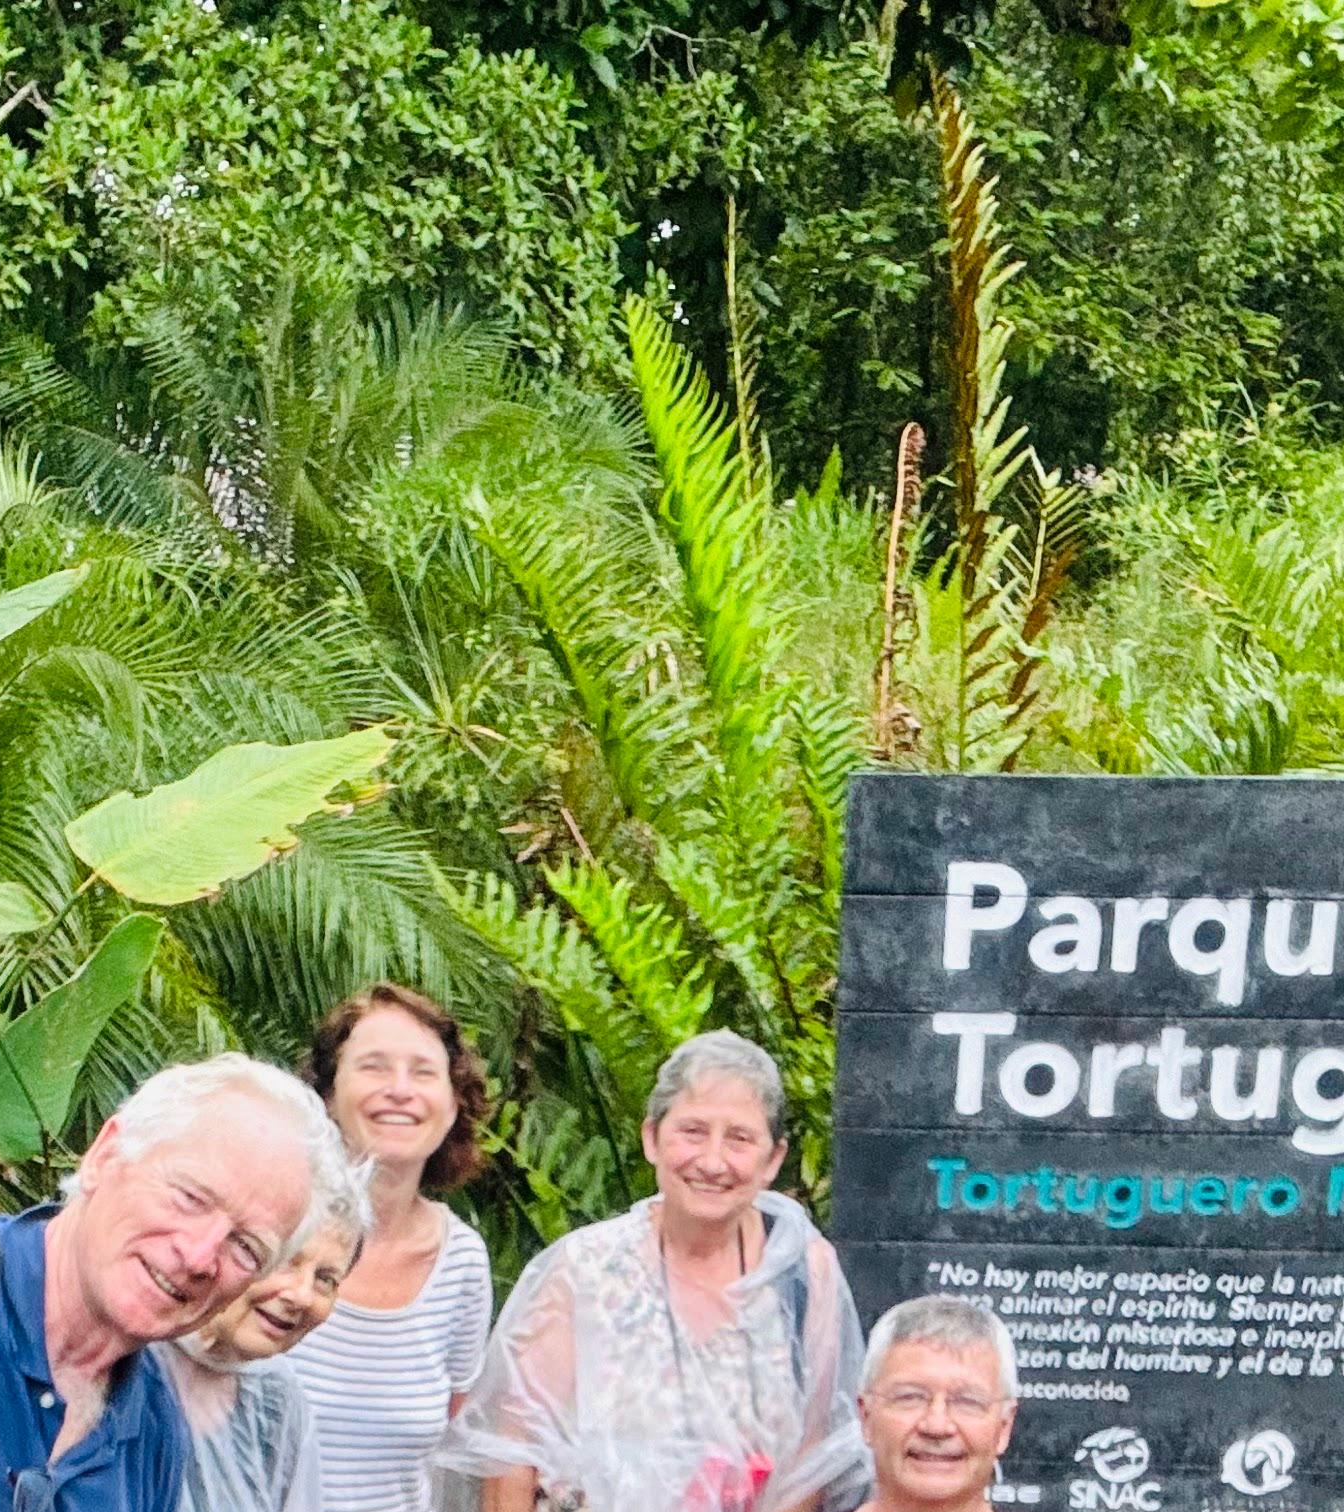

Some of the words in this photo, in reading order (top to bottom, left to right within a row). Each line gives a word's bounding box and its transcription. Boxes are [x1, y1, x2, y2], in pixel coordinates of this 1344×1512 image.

[927, 1156, 1301, 1230] Tortuguero
[983, 1262, 1029, 1294] hay
[1034, 1263, 1109, 1295] mejor
[1112, 1268, 1211, 1296] espacio
[1215, 1273, 1265, 1298] que
[1271, 1265, 1295, 1295] la
[999, 1292, 1089, 1316] animar
[1091, 1291, 1117, 1316] el
[1229, 1295, 1335, 1327] Siempre
[1005, 1317, 1100, 1343] onexión
[1107, 1320, 1237, 1347] misteriosa
[1240, 1328, 1259, 1347] e
[1067, 1344, 1110, 1370] del
[1114, 1346, 1212, 1373] hombre
[1216, 1356, 1233, 1379] y
[1238, 1349, 1265, 1374] el
[1268, 1350, 1304, 1376] de
[1309, 1349, 1334, 1376] la
[1069, 1479, 1162, 1511] SINAC
